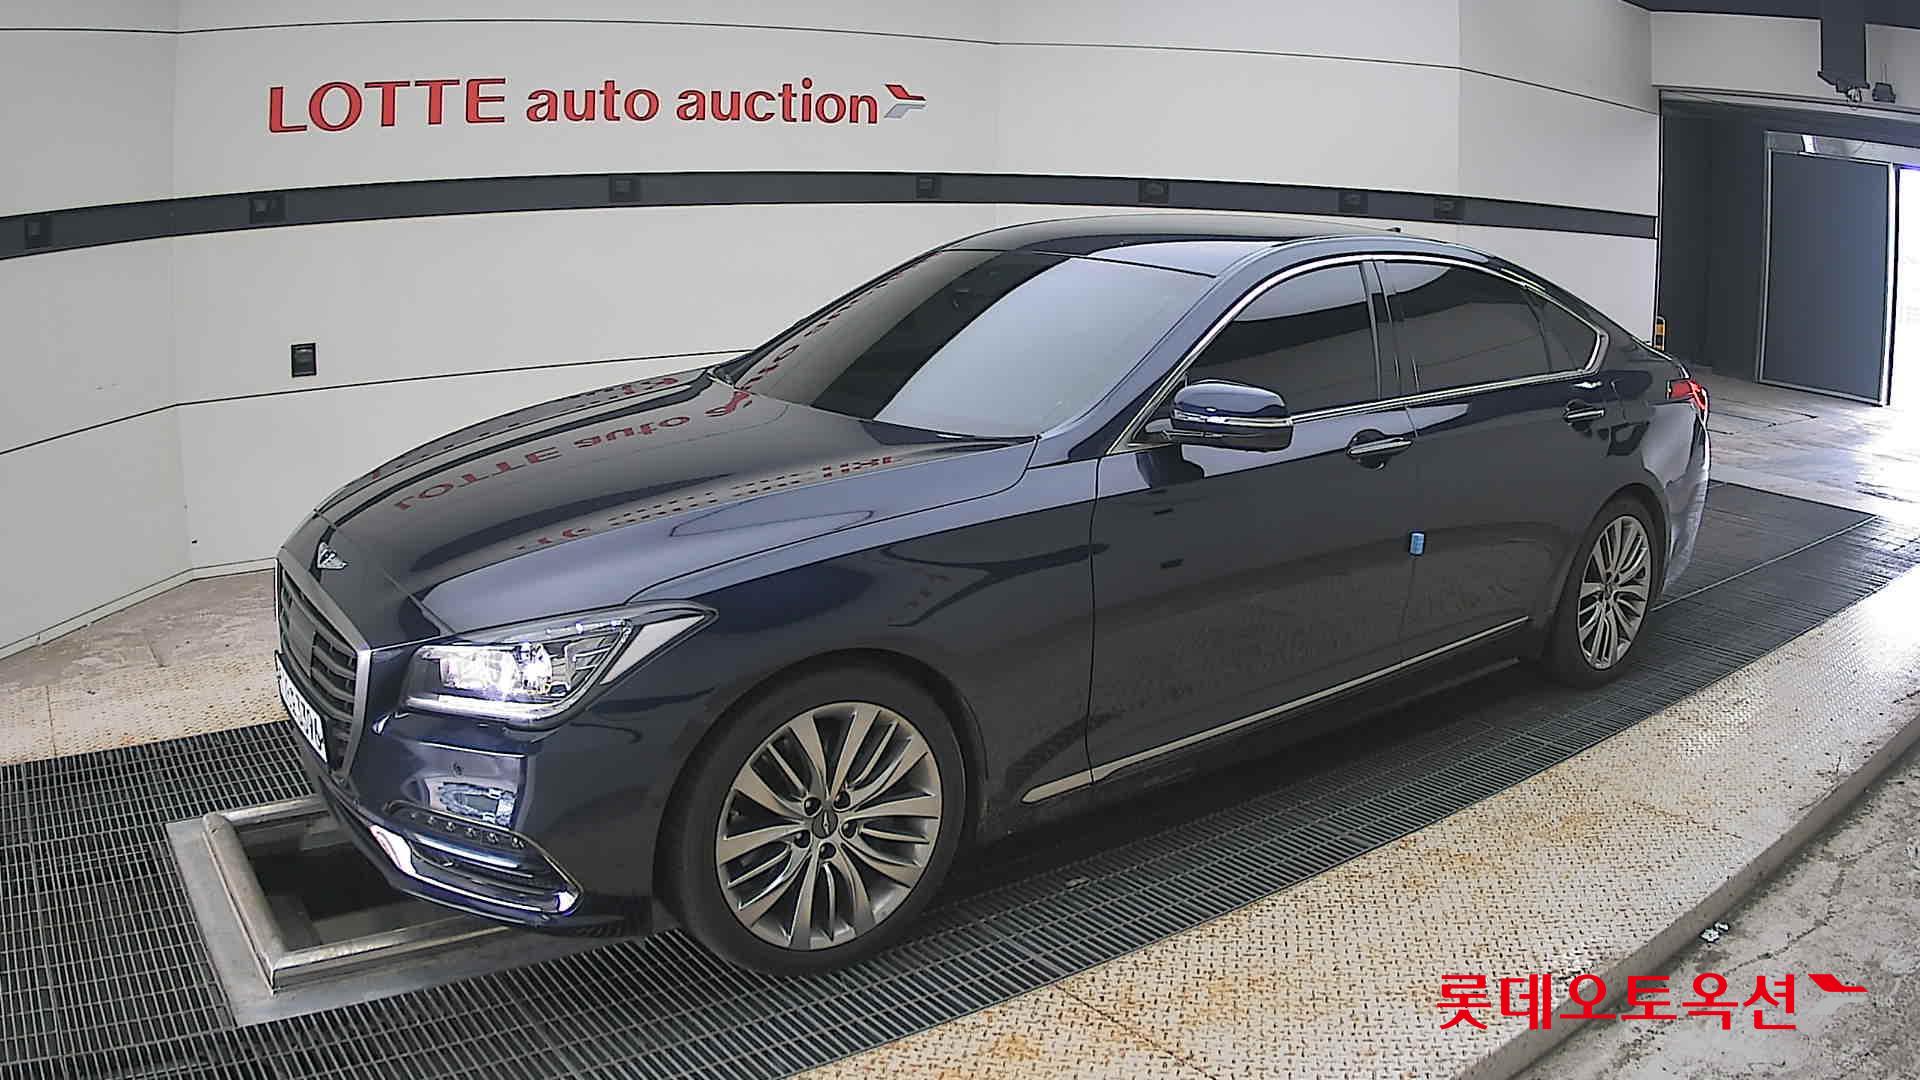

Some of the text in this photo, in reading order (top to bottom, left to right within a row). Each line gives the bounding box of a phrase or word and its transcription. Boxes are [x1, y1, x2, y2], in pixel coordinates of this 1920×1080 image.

[268, 78, 879, 134] LOTTE auto auction
